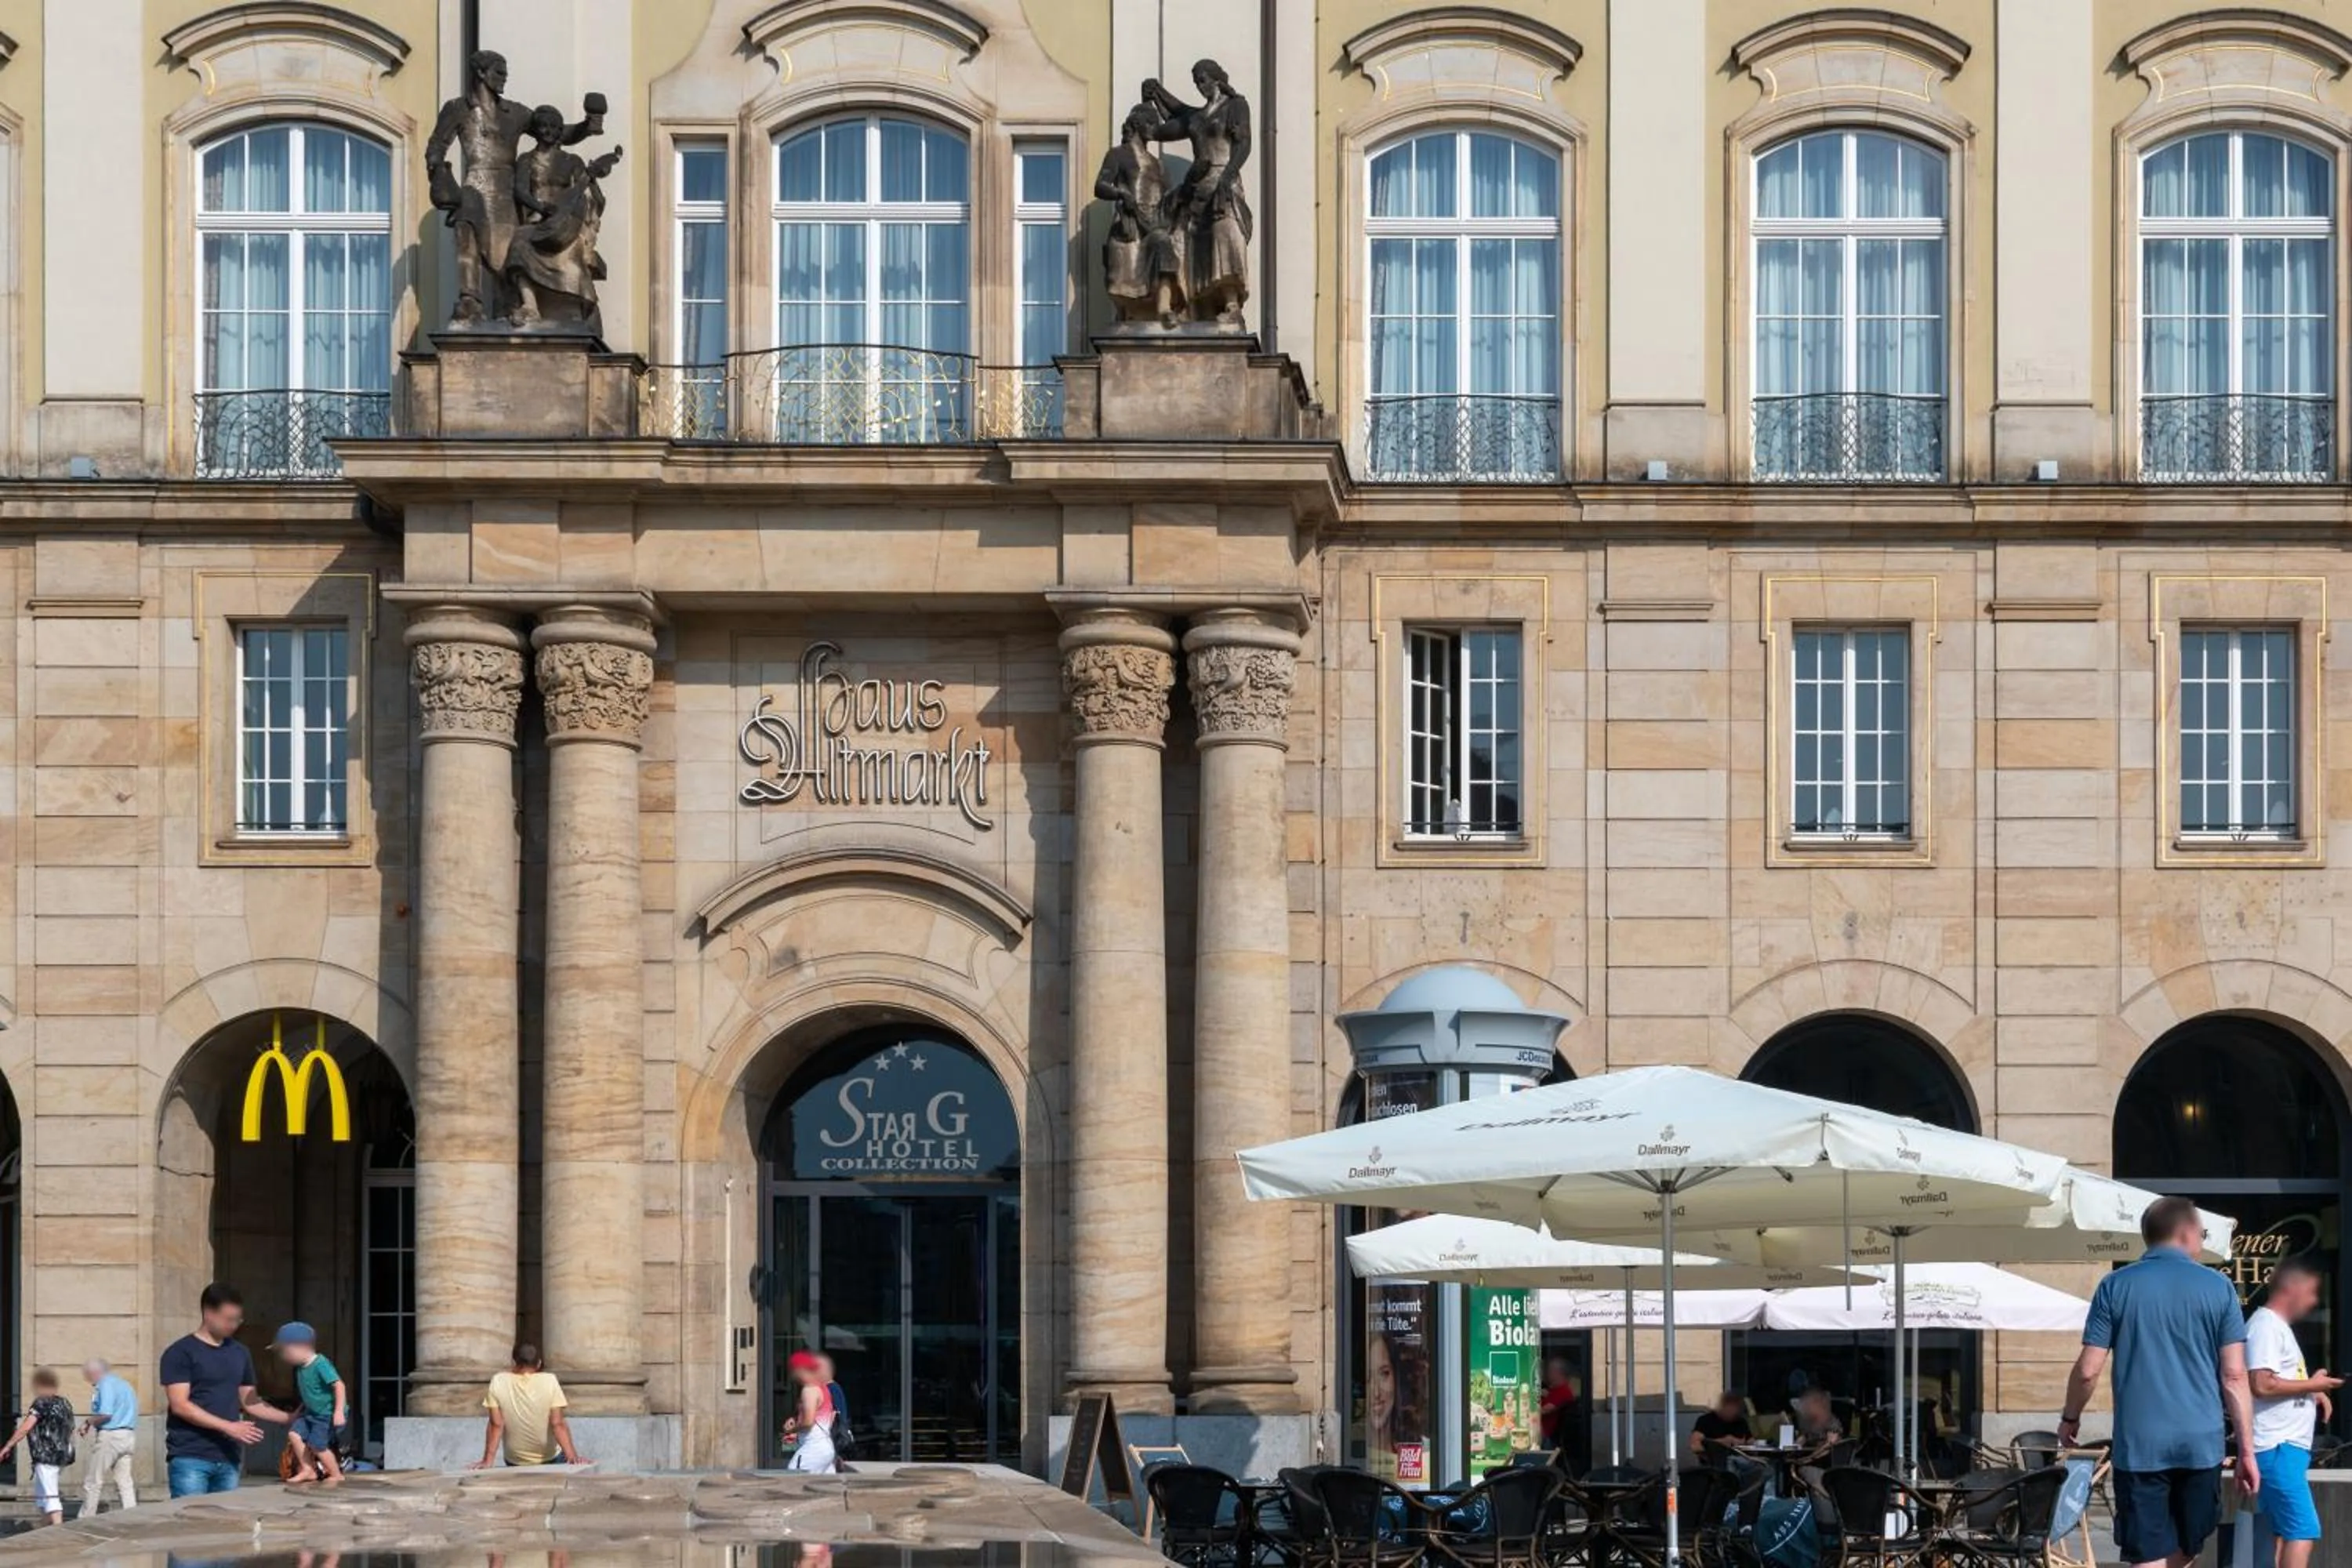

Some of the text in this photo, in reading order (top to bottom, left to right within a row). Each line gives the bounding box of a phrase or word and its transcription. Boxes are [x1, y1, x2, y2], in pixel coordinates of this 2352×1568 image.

[739, 695, 993, 829] Altmarkt
[926, 1091, 969, 1136] G
[866, 1138, 979, 1158] HOTEL
[1637, 1143, 1691, 1156] Dallmayr
[821, 1157, 978, 1171] COLLECTION
[1348, 1166, 1398, 1179] Dallmayr
[2230, 1233, 2290, 1254] ener
[1489, 1294, 1521, 1316] Alle
[1488, 1318, 1541, 1346] Biola
